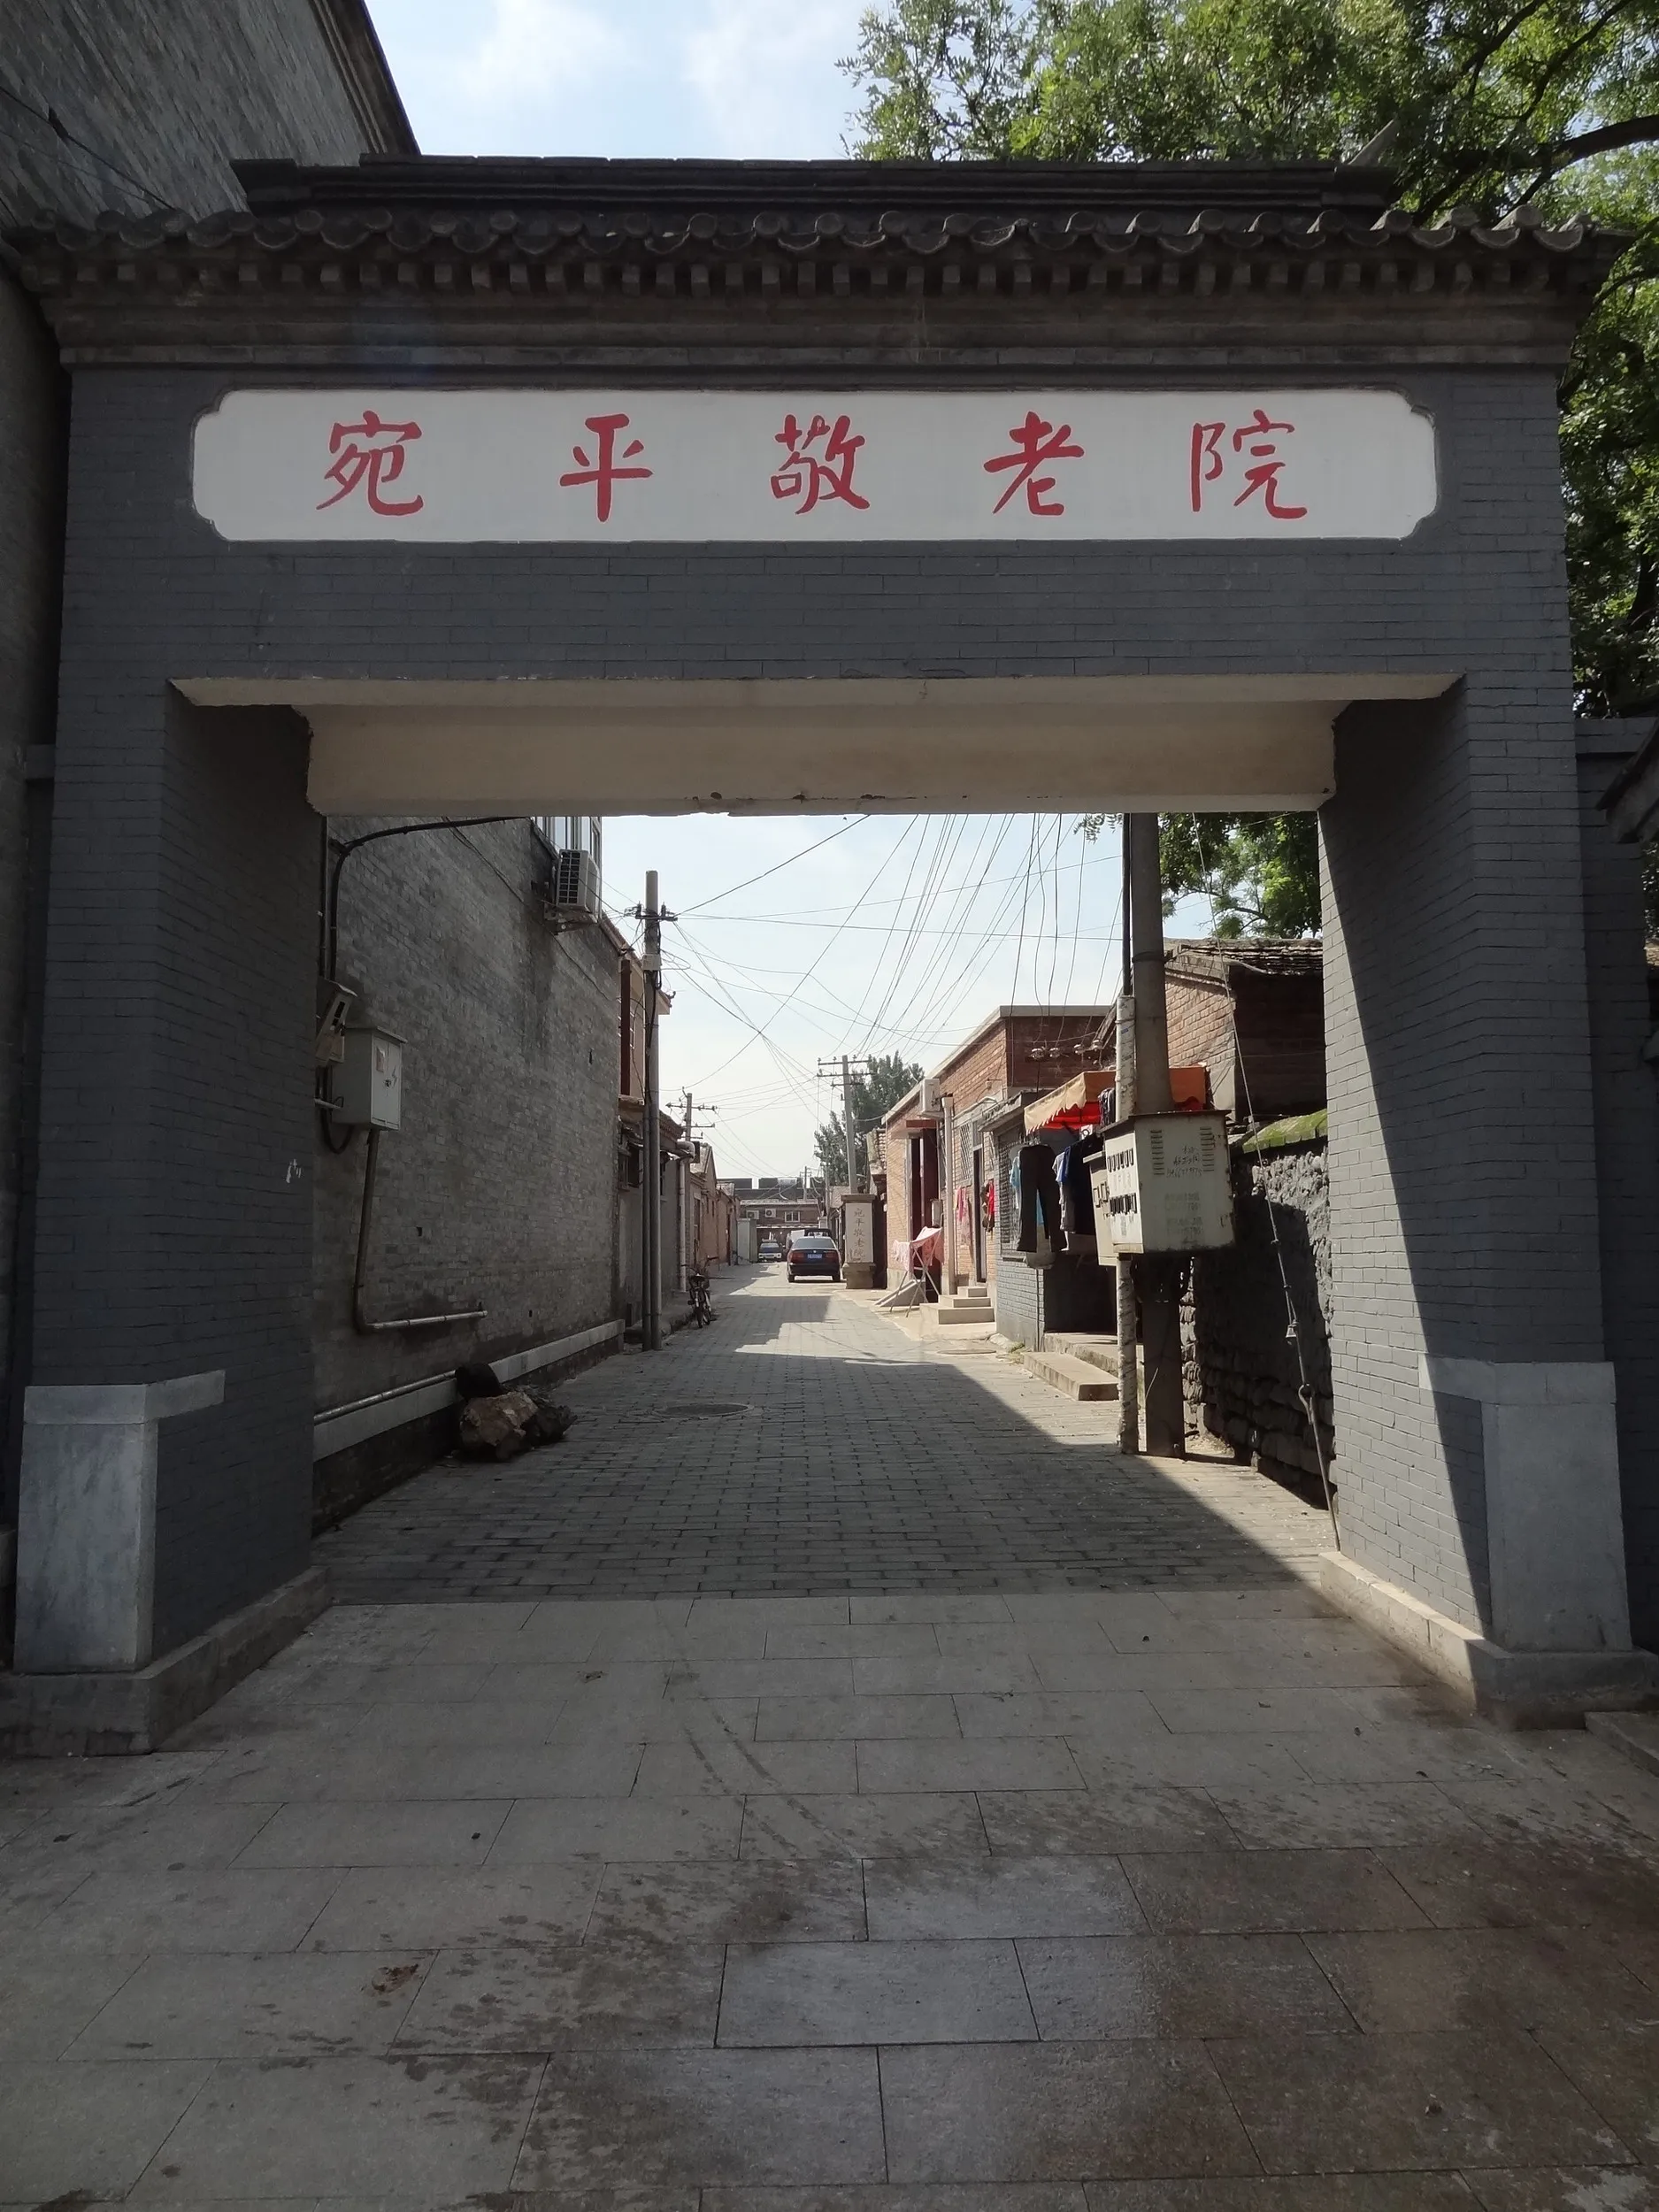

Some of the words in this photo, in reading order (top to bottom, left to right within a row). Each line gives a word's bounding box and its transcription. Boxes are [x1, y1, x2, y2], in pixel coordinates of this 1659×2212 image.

[315, 410, 1308, 520] 宛平敬老院
[853, 1207, 866, 1257] 宛平敬老院
